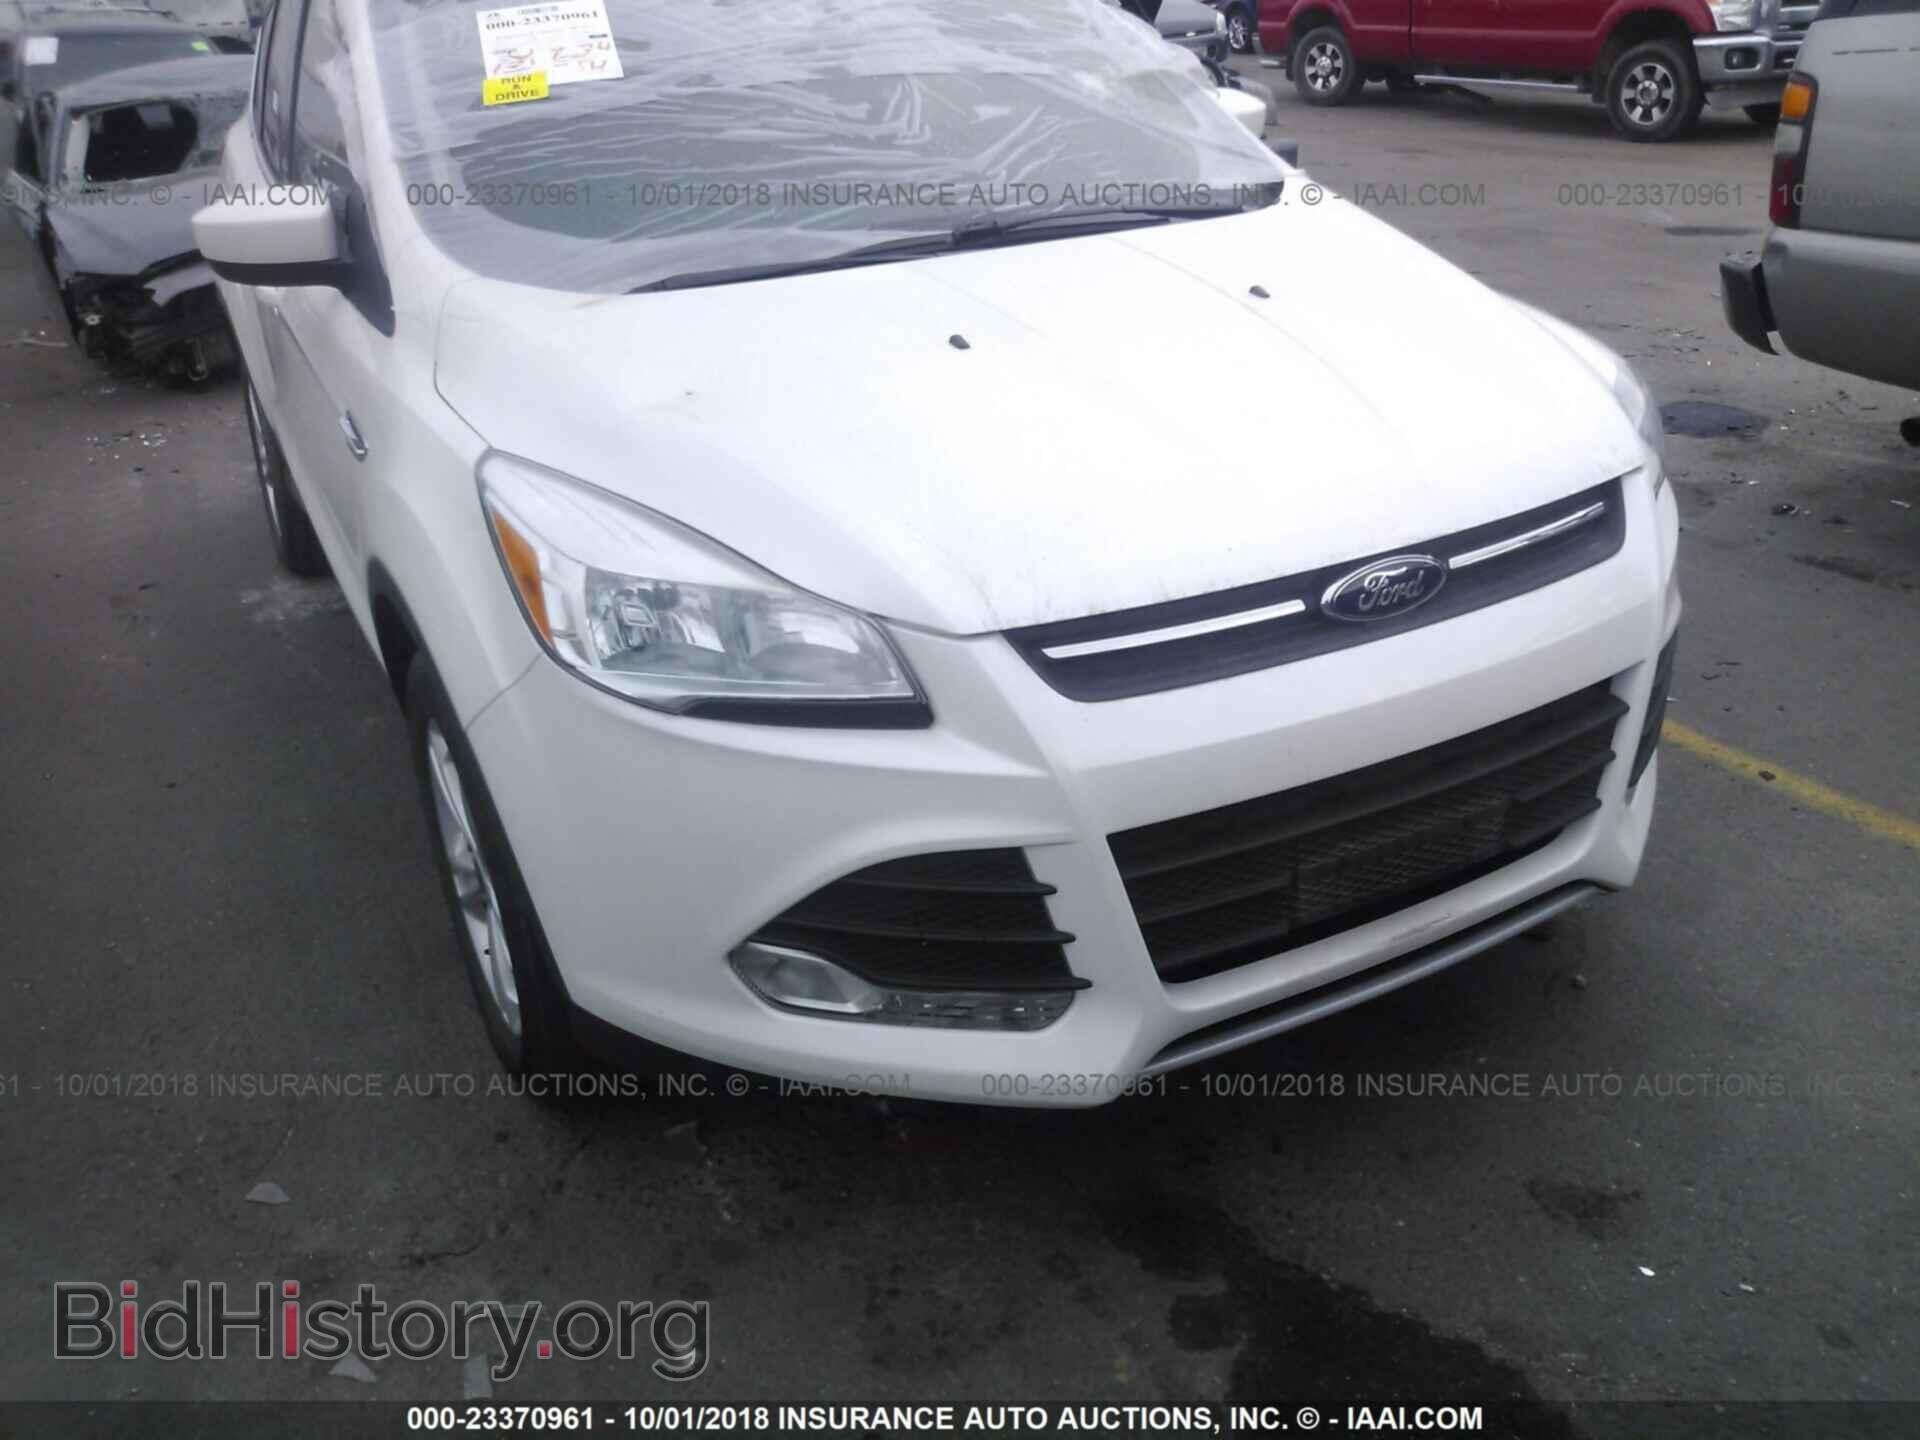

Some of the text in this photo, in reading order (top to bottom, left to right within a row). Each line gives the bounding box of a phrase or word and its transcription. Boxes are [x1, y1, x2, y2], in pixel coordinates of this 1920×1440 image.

[501, 74, 532, 85] RUN
[495, 89, 540, 101] DRIVE
[1358, 566, 1424, 611] Ford
